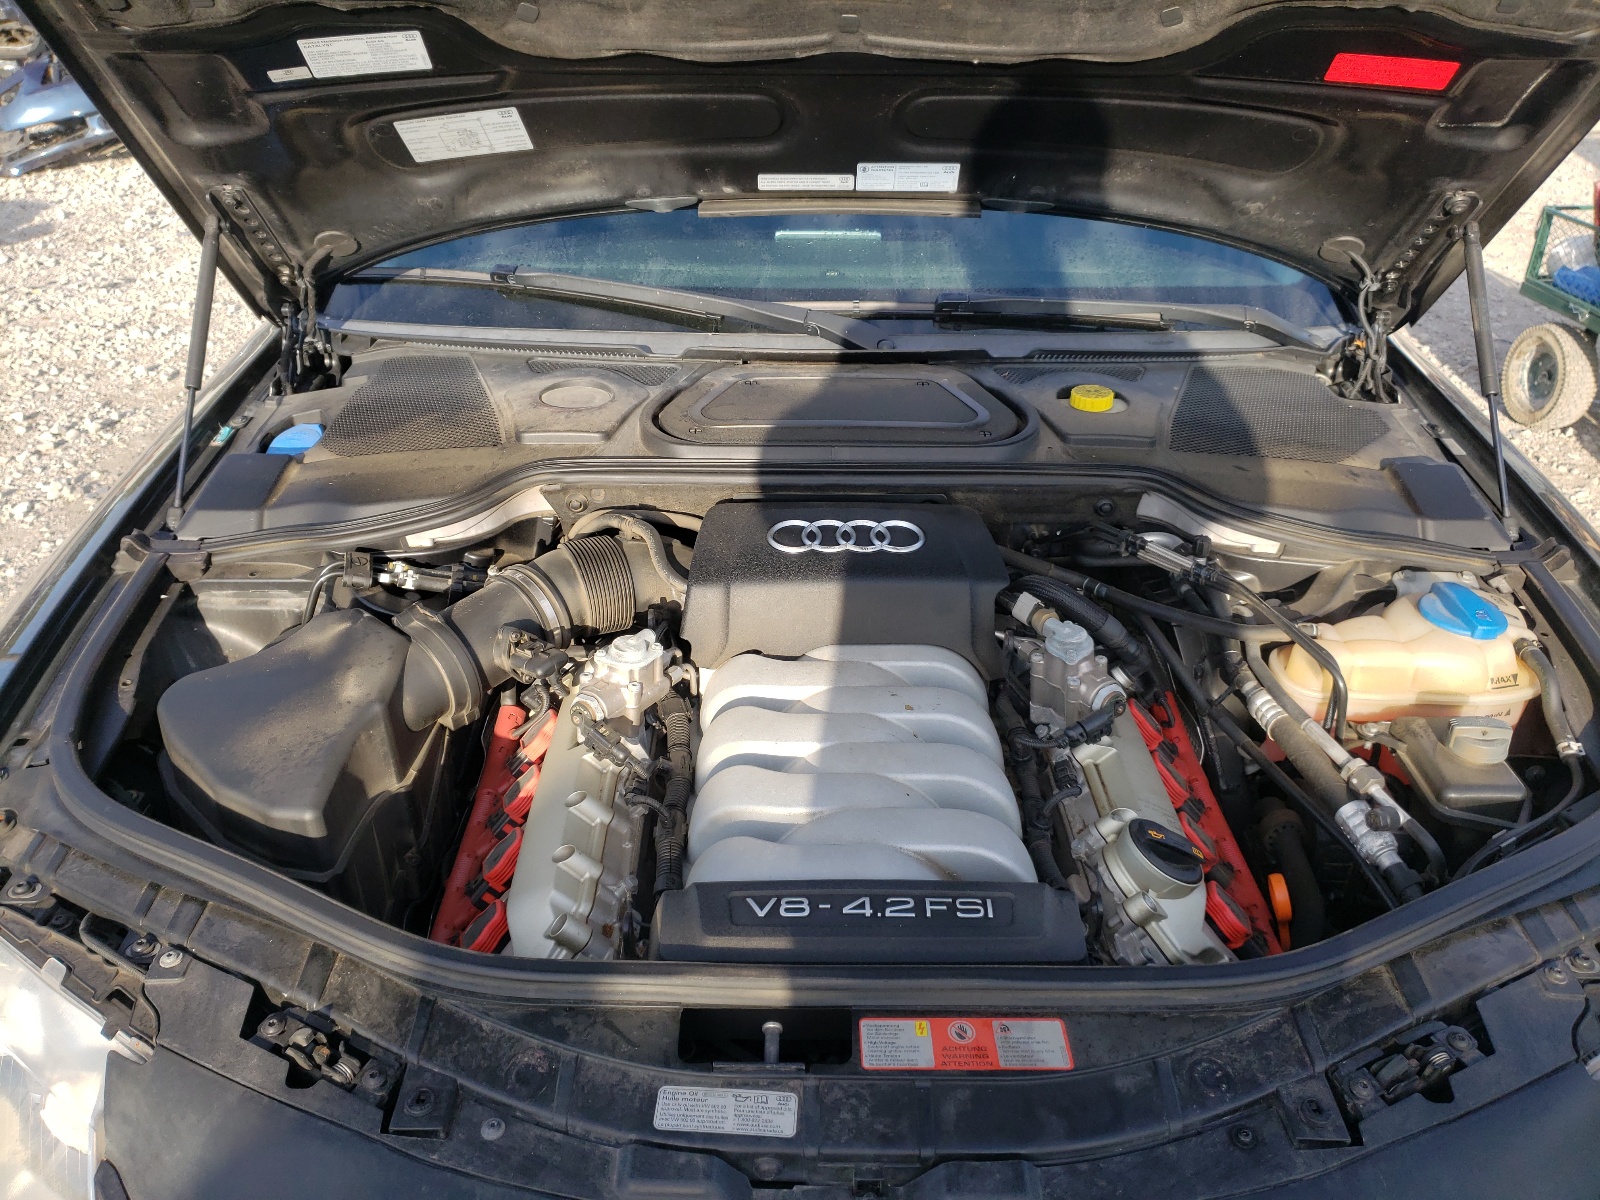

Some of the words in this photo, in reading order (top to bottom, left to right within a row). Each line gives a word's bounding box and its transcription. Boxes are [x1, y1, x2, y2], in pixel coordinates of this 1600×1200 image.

[1490, 675, 1511, 684] MAX
[746, 897, 810, 917] V8
[842, 897, 915, 917] 4.2
[926, 898, 994, 918] FSI
